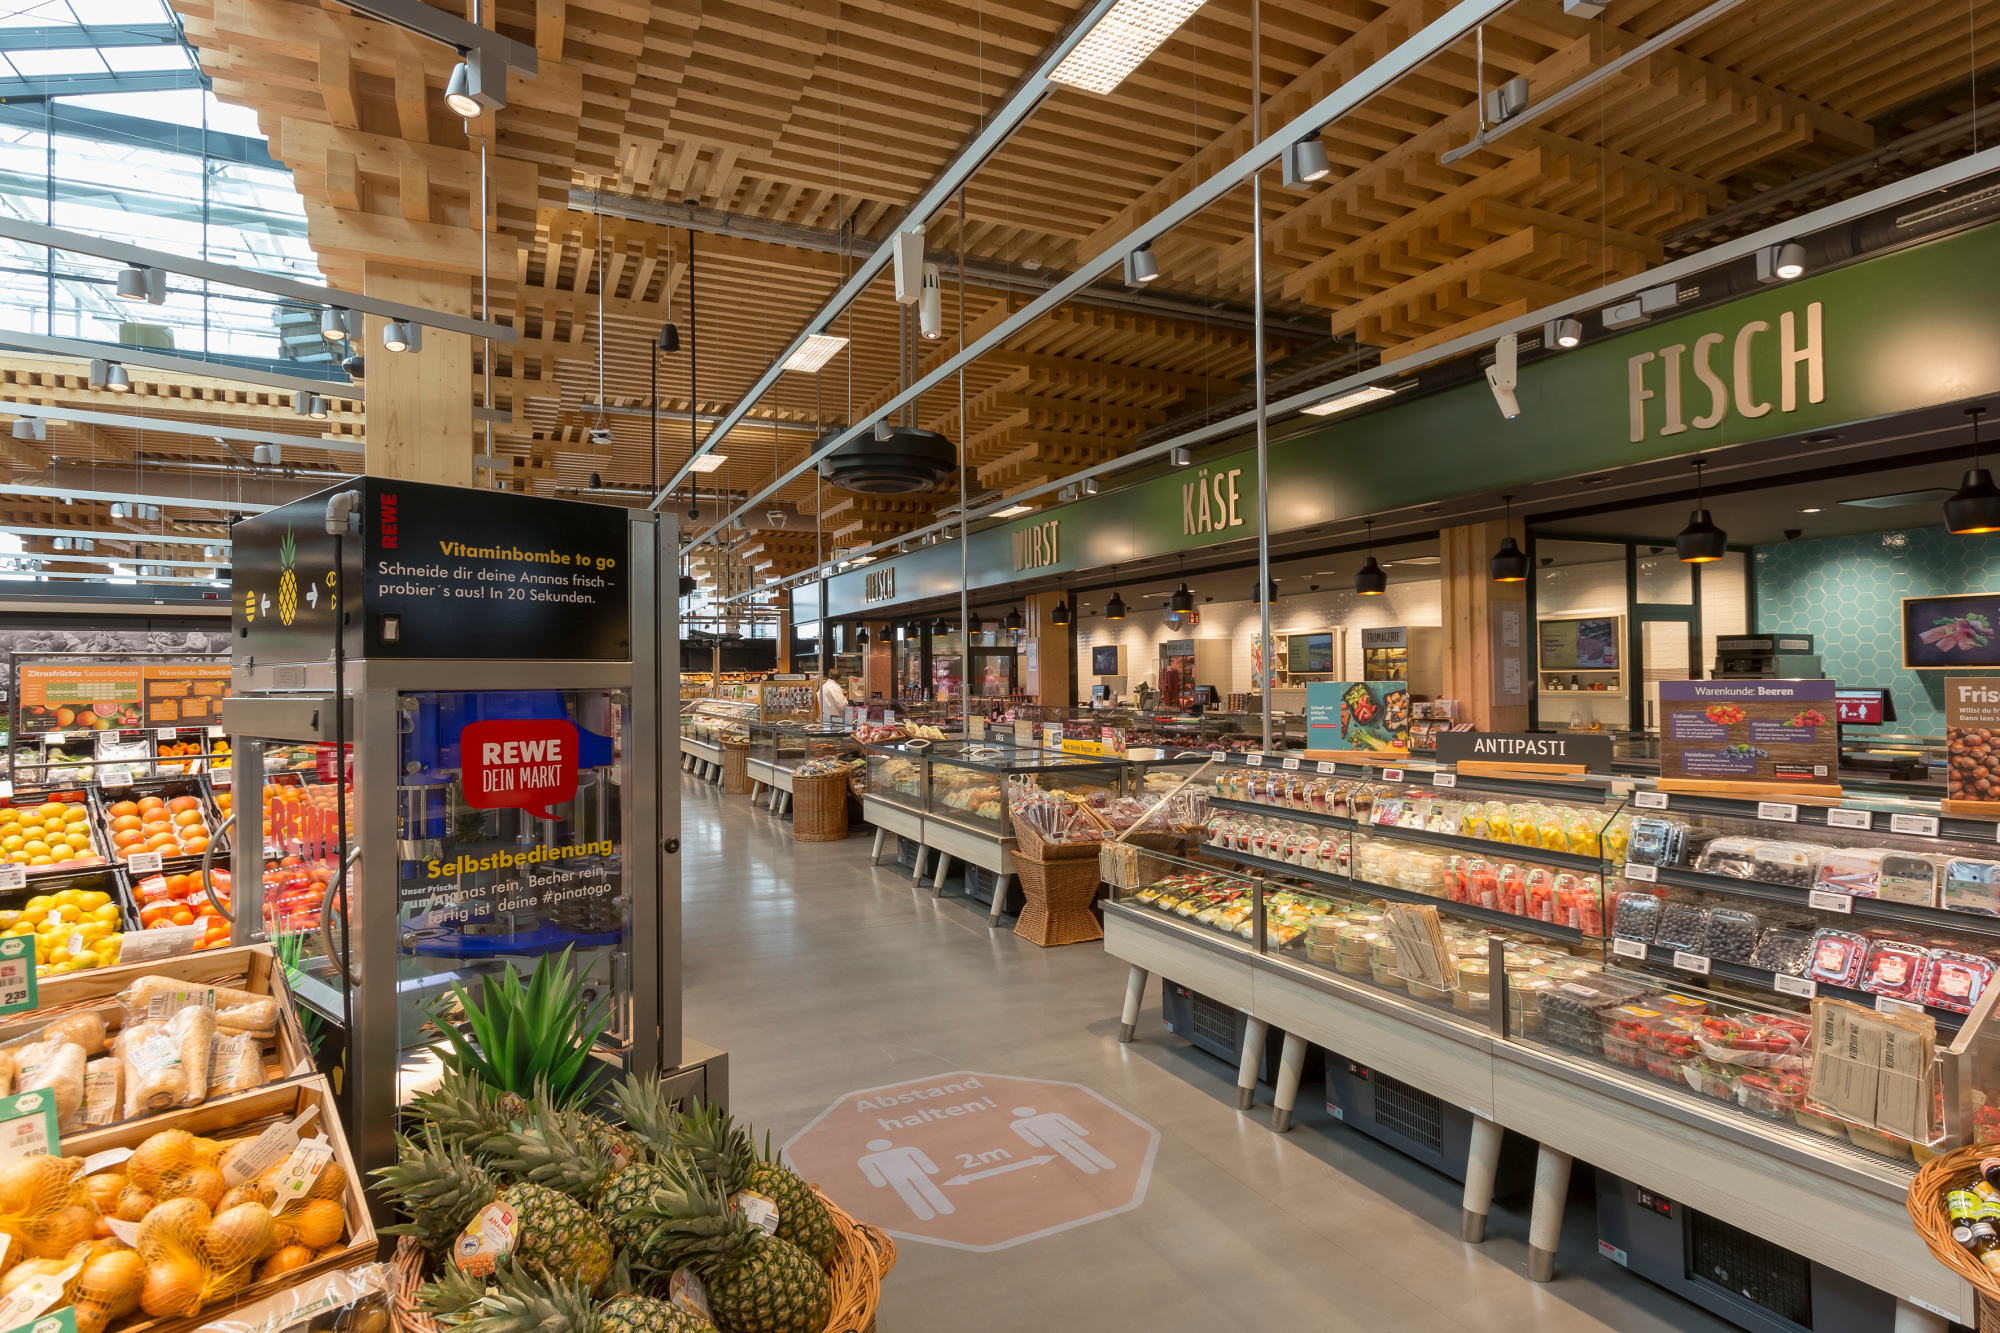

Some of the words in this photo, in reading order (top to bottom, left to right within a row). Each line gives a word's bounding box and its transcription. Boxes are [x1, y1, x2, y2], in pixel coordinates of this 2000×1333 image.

[1628, 302, 1825, 443] FISCH
[1183, 469, 1243, 535] KÄSE
[380, 494, 398, 548] REWE
[439, 540, 570, 565] Vitaminbombe
[575, 553, 591, 566] to
[595, 557, 616, 571] go
[1012, 520, 1059, 572] WURST
[378, 561, 449, 578] Schneide
[453, 567, 473, 580] dir
[477, 569, 516, 583] deine
[520, 571, 569, 586] Ananas
[572, 573, 604, 588] frisch
[455, 586, 485, 599] aus!
[490, 587, 503, 600] In
[507, 588, 526, 601] 20
[529, 588, 596, 604] Sekunden.
[1367, 632, 1400, 643] FROMAGERIE
[27, 669, 82, 678] Zitrusfrüchte
[83, 669, 139, 677] Saisonkalender
[1695, 686, 1755, 697] Warenkunde:
[1758, 686, 1794, 696] Beeren
[1958, 685, 2000, 703] Fris
[482, 739, 562, 766] REWE
[1063, 742, 1071, 750] Aus
[1474, 738, 1566, 756] ANTIPASTI
[482, 768, 514, 793] DEIN
[519, 764, 562, 790] MARKT
[271, 797, 339, 869] REWE
[427, 839, 613, 879] Selbstbedienung
[401, 887, 427, 896] Unser
[427, 883, 459, 893] Frische
[428, 886, 486, 905] Ananas
[491, 877, 524, 895] rein,
[528, 869, 575, 889] Becher
[578, 865, 608, 880] rein,
[427, 907, 469, 925] fertig
[474, 902, 491, 917] ist
[497, 894, 538, 912] deine
[542, 882, 612, 905] #pinatogo
[1826, 1010, 1836, 1021] ZUM
[1824, 1021, 1834, 1047] AUSGABELN
[1850, 1023, 1859, 1035] ZUM
[1886, 1031, 1896, 1042] ZUM
[1849, 1034, 1858, 1060] AUSGABELN
[1885, 1041, 1895, 1069] AUSGABELN
[856, 1076, 985, 1113] Abstand
[876, 1095, 998, 1132] halten!
[954, 1147, 1013, 1169] 2m
[488, 1216, 510, 1239] ANANAS
